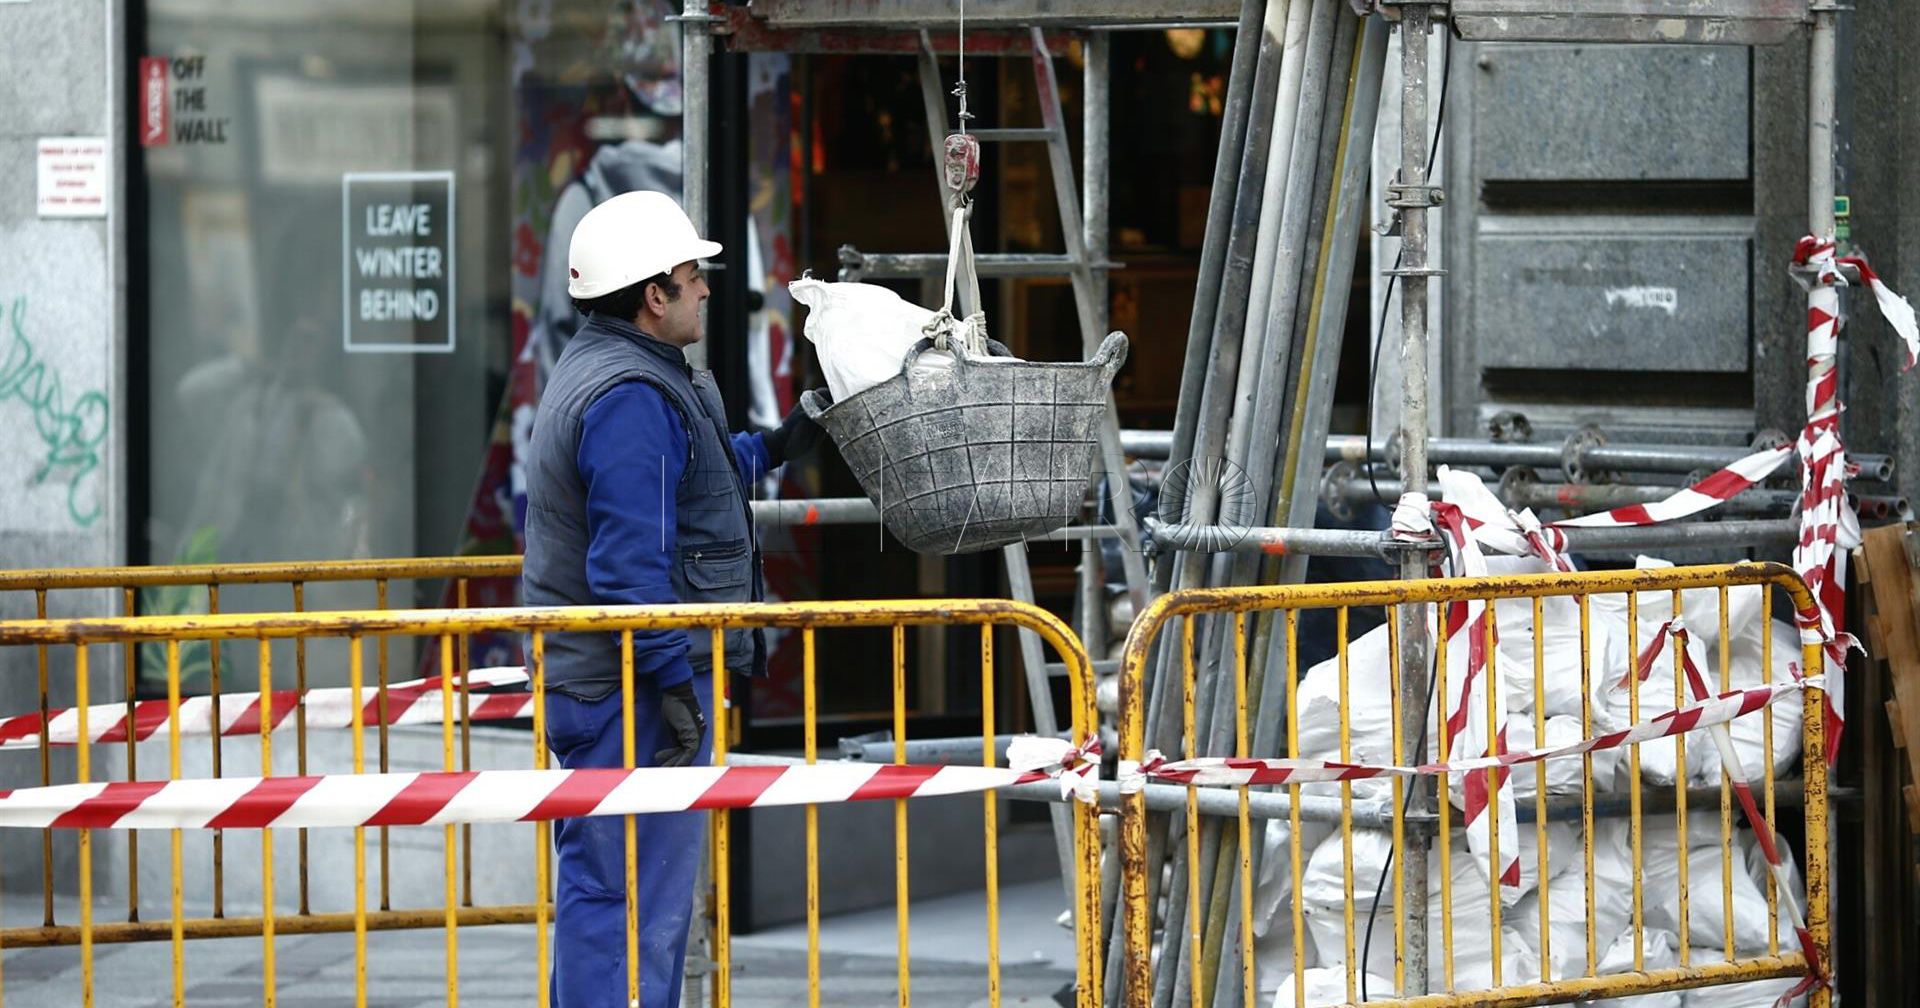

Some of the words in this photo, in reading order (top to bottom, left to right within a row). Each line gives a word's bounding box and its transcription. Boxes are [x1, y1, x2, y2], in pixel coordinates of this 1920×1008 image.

[175, 87, 206, 111] THE
[366, 204, 432, 236] LEAVE
[355, 247, 442, 279] WINTER
[360, 288, 440, 321] BEHIND
